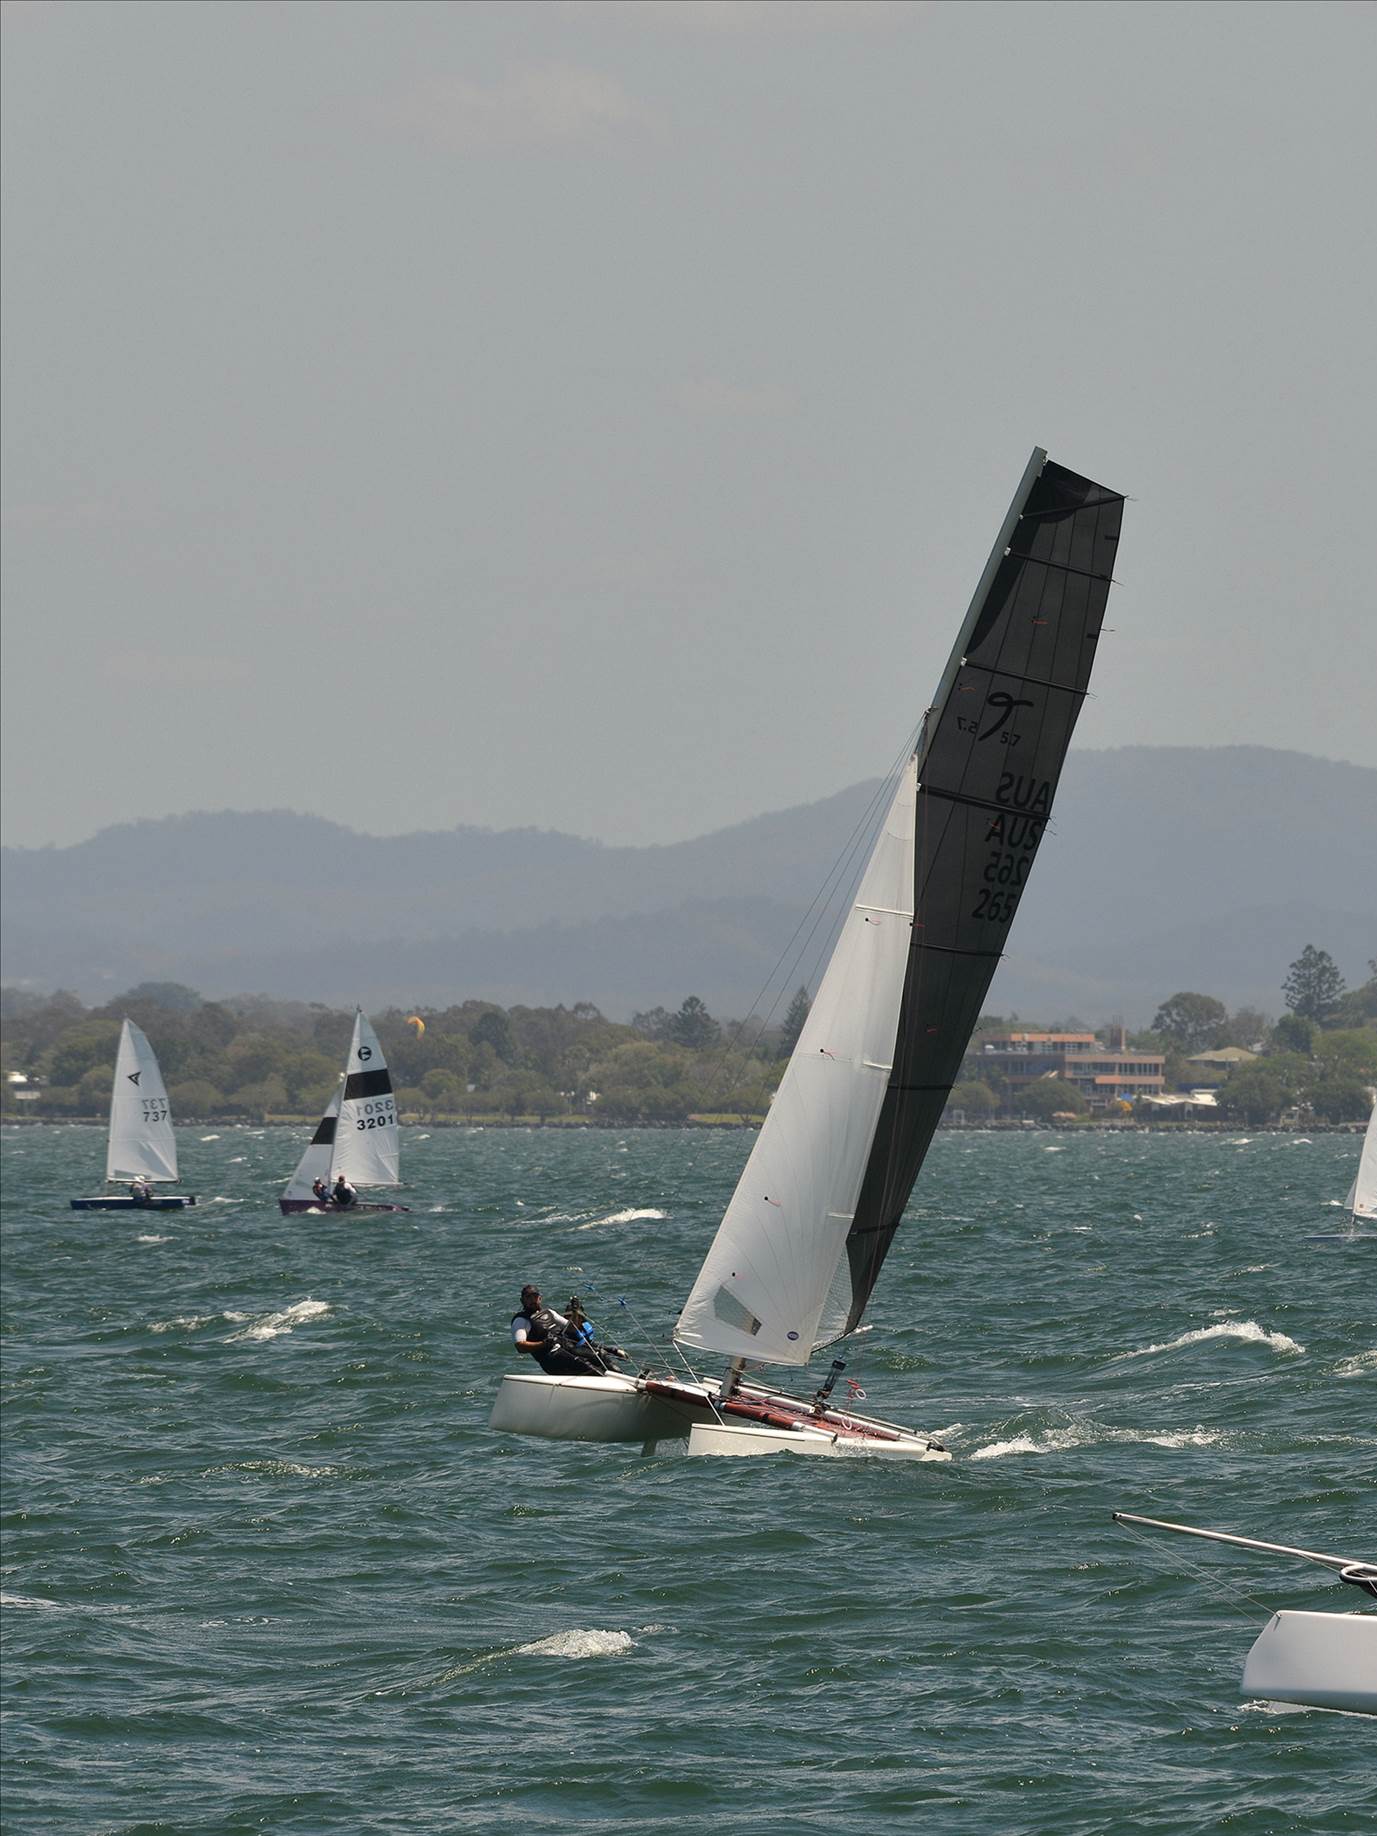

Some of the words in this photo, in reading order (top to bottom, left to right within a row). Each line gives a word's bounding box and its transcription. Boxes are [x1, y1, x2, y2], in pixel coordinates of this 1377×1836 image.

[985, 814, 1045, 850] AUS
[143, 1110, 167, 1122] 737
[356, 1114, 394, 1131] 3201
